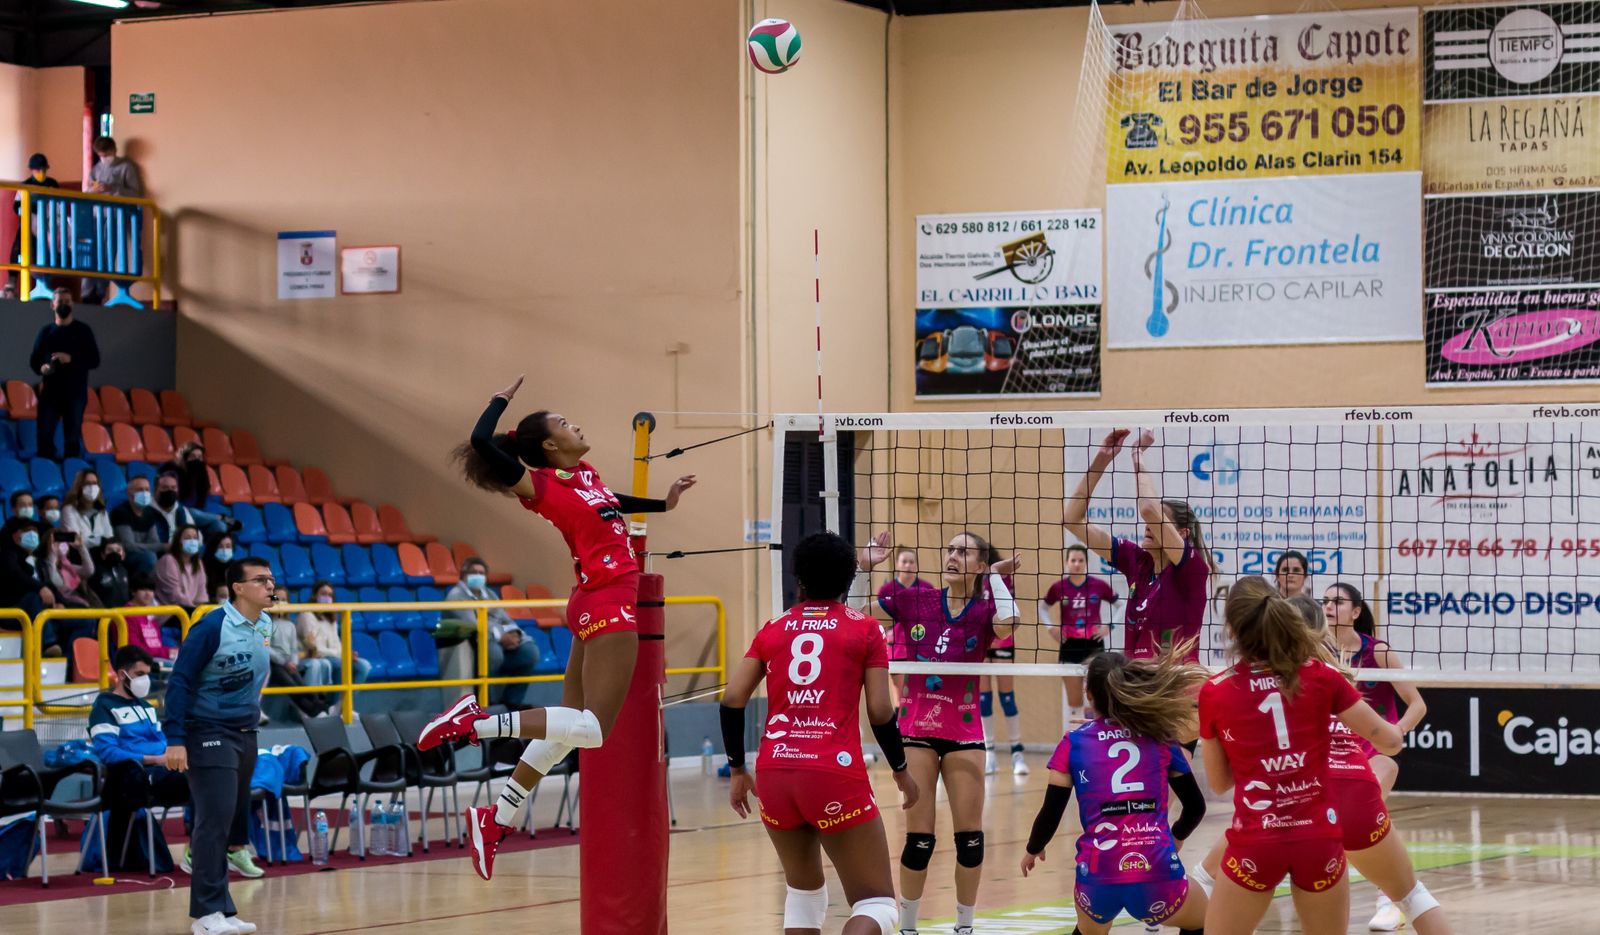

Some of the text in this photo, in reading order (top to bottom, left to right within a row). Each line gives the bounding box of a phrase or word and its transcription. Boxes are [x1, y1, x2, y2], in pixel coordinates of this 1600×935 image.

[1113, 22, 1410, 73] Bodeguita Capote
[1498, 35, 1554, 52] TIEMPO
[1159, 74, 1363, 102] El Bar de Jorge
[1179, 104, 1405, 145] 955 671 050
[1469, 106, 1491, 143] LA
[1500, 141, 1549, 152] TAPAS
[1124, 160, 1153, 175] Av.
[1159, 155, 1248, 175] Leopoldo
[1254, 153, 1296, 170] Alas
[1369, 148, 1402, 165] 154
[1486, 164, 1568, 176] DOS HERMANAS
[1188, 195, 1293, 227] Clínica
[936, 218, 1095, 235] 629 580 812 / 661 228 142
[1515, 230, 1574, 243] COLONIAS
[1188, 234, 1381, 269] Dr. Frontela
[1484, 245, 1502, 257] DE
[921, 285, 1097, 302] EL CARRILLO BAR
[1184, 279, 1384, 305] INJERTO CAPILAR
[1433, 291, 1521, 310] Especialidad
[1523, 293, 1539, 304] en
[1543, 291, 1585, 304] buena
[1431, 369, 1454, 380] Avd.
[1457, 368, 1497, 381] España,
[1501, 366, 1518, 378] 110
[1530, 366, 1562, 378] Frente
[1564, 369, 1571, 377] a
[990, 414, 1053, 425] rfevb.com
[1164, 412, 1229, 424] rfevb.com
[1345, 409, 1413, 421] rfevb.com
[1398, 456, 1558, 495] ANATOLIA
[1088, 507, 1135, 518] ENTRO
[1244, 506, 1273, 518] DOS
[1279, 505, 1364, 517] HERMANAS
[1220, 532, 1251, 541] 41702
[1253, 532, 1272, 541] Dos
[1275, 532, 1325, 541] Hermanas
[1327, 531, 1367, 542] (Sevilla)
[1398, 538, 1437, 558] 607
[1445, 538, 1471, 557] 78
[1477, 538, 1504, 557] 66
[1511, 538, 1537, 558] 78
[1544, 537, 1553, 560] /
[1306, 550, 1344, 574] 51
[1387, 592, 1600, 615] ESPACIO DISP
[784, 618, 838, 631] M. FRIAS
[788, 633, 824, 686] 8
[787, 690, 825, 706] WAY
[792, 716, 838, 730] Andalucía
[1258, 692, 1290, 750] 1
[1108, 740, 1145, 794] 2
[1261, 752, 1307, 773] WAY
[817, 807, 862, 830] Divisa
[1226, 856, 1267, 890] Divisa
